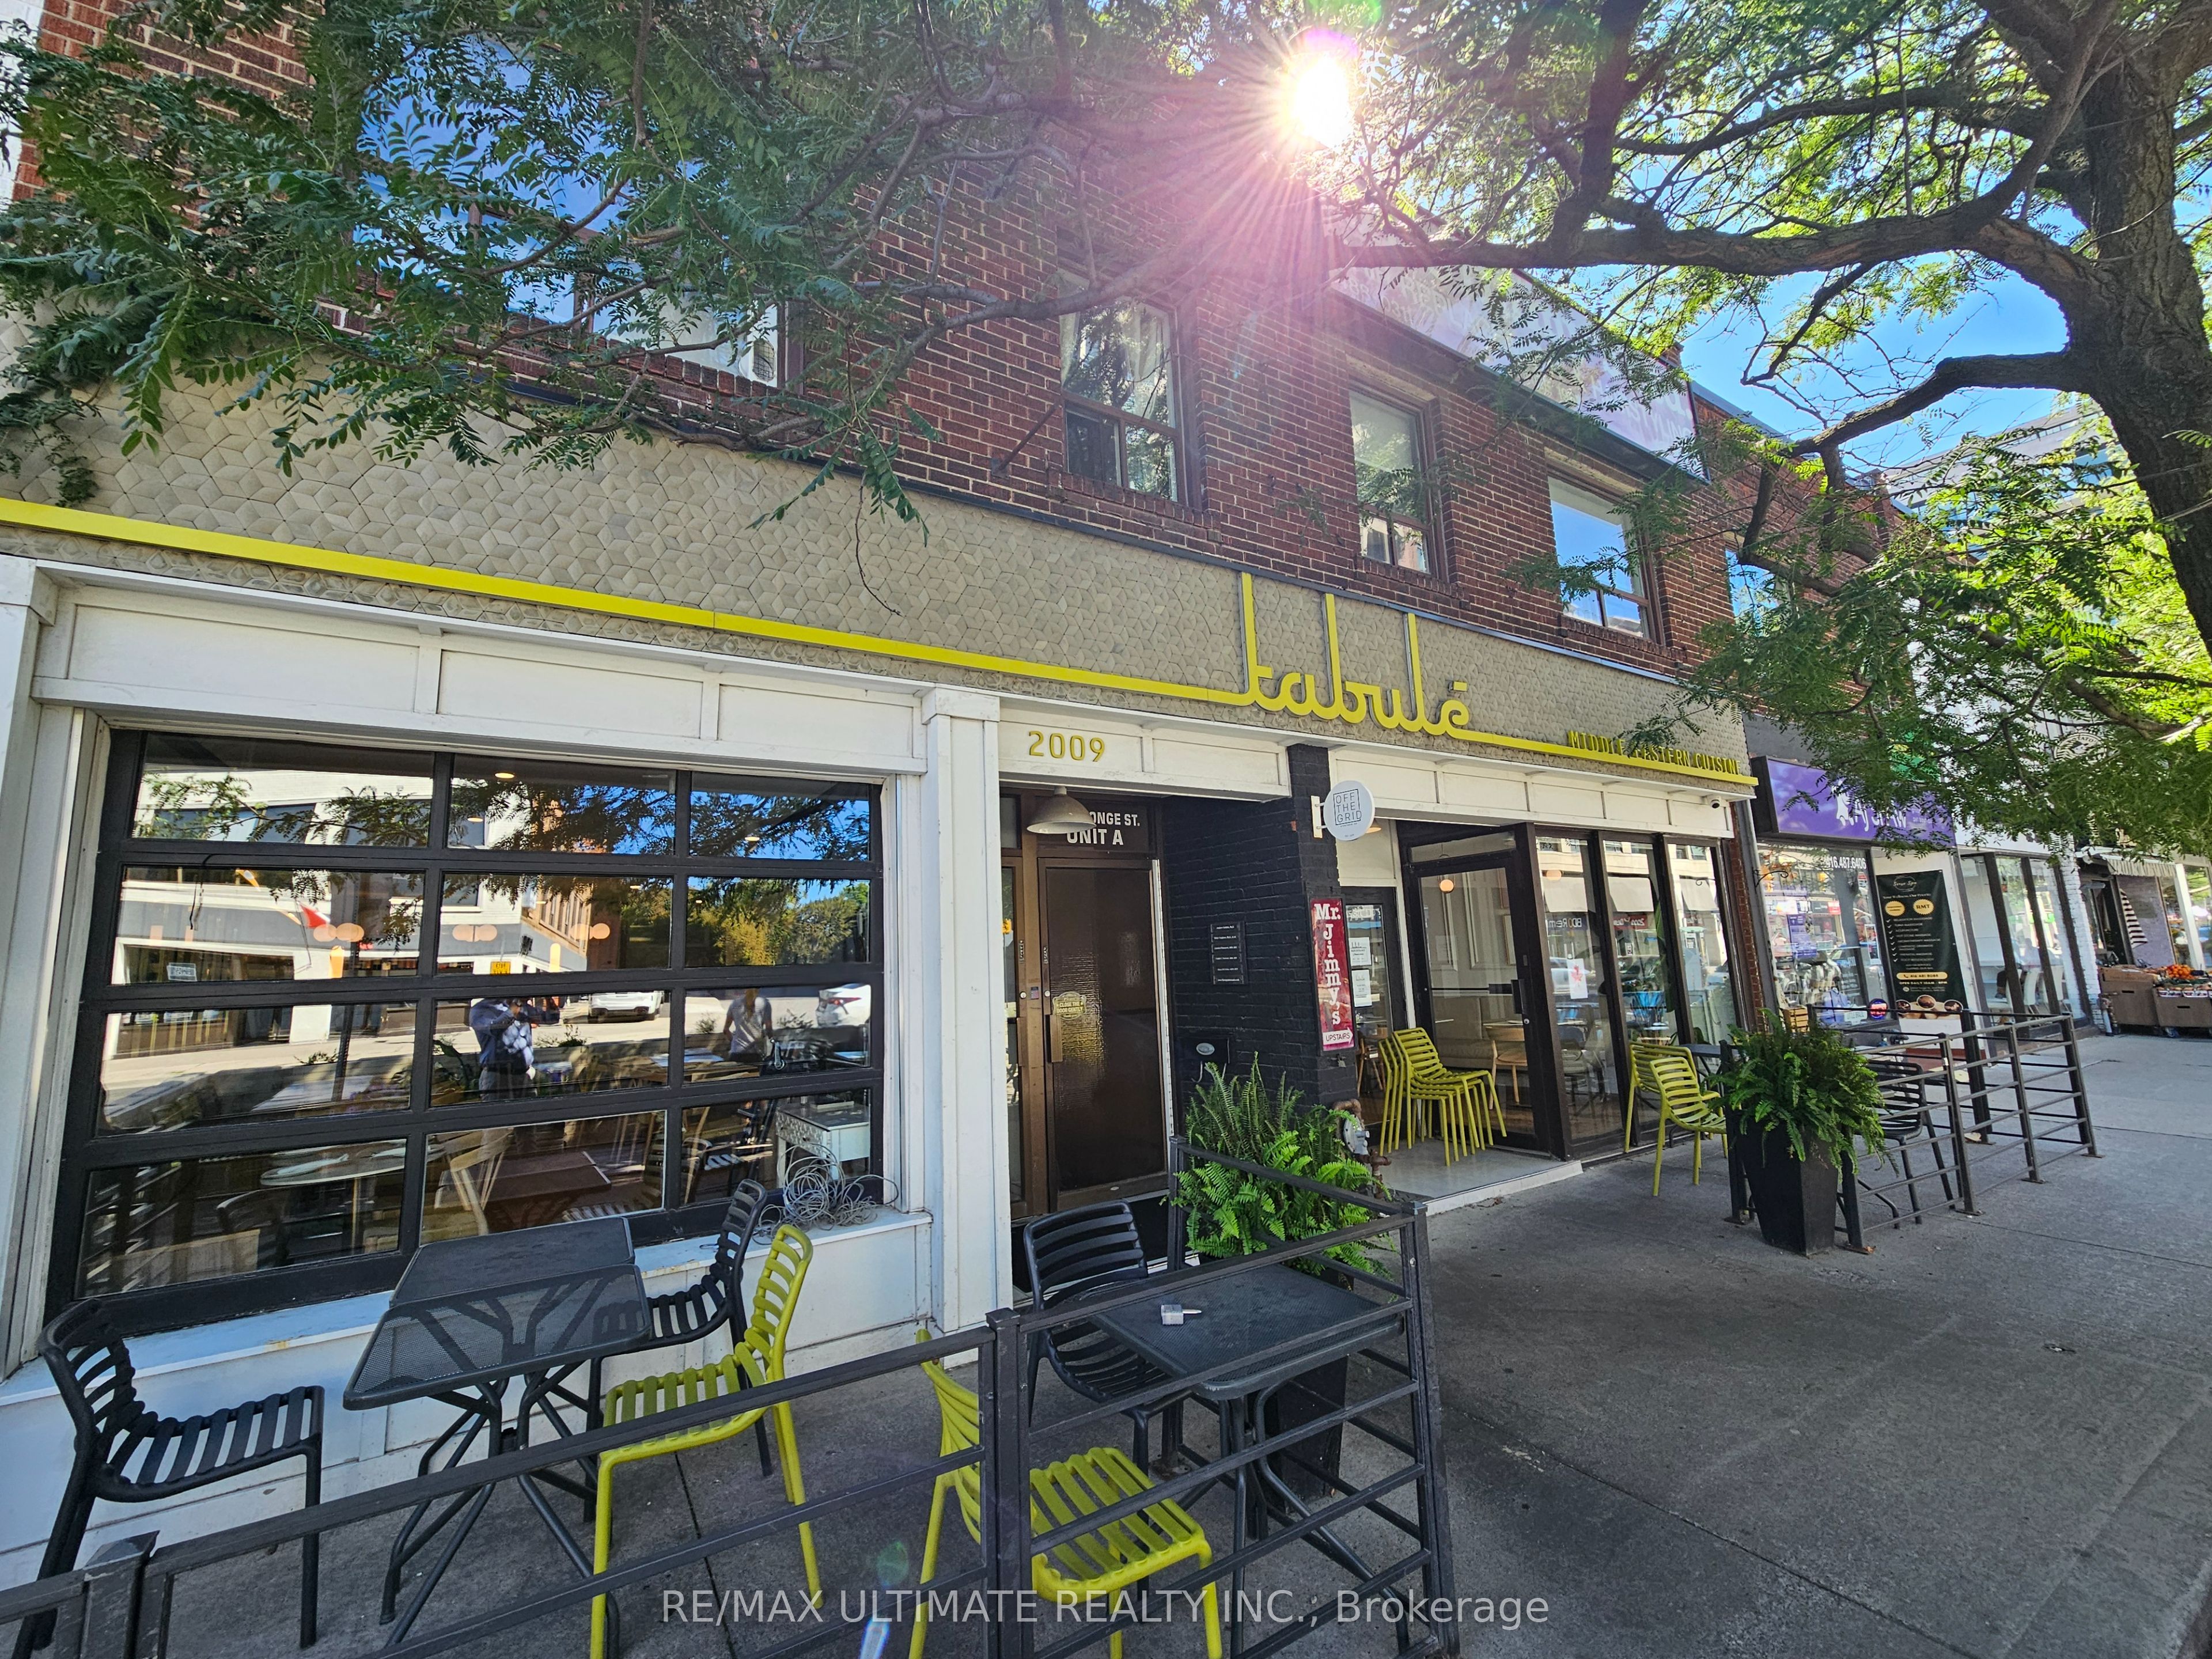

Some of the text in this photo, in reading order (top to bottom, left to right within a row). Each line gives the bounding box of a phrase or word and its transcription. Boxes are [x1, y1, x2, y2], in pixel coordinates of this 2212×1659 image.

[1029, 730, 1105, 762] 2009
[1694, 753, 1741, 775] CUISINE
[1335, 792, 1355, 804] OFF
[1336, 802, 1356, 813] THE
[1090, 812, 1141, 827] ONGE ST.
[1337, 810, 1362, 823] GRID
[1067, 828, 1124, 845] UNIT A
[1314, 903, 1341, 920] Mr.
[1325, 1032, 1350, 1041] UPSTAIRS
